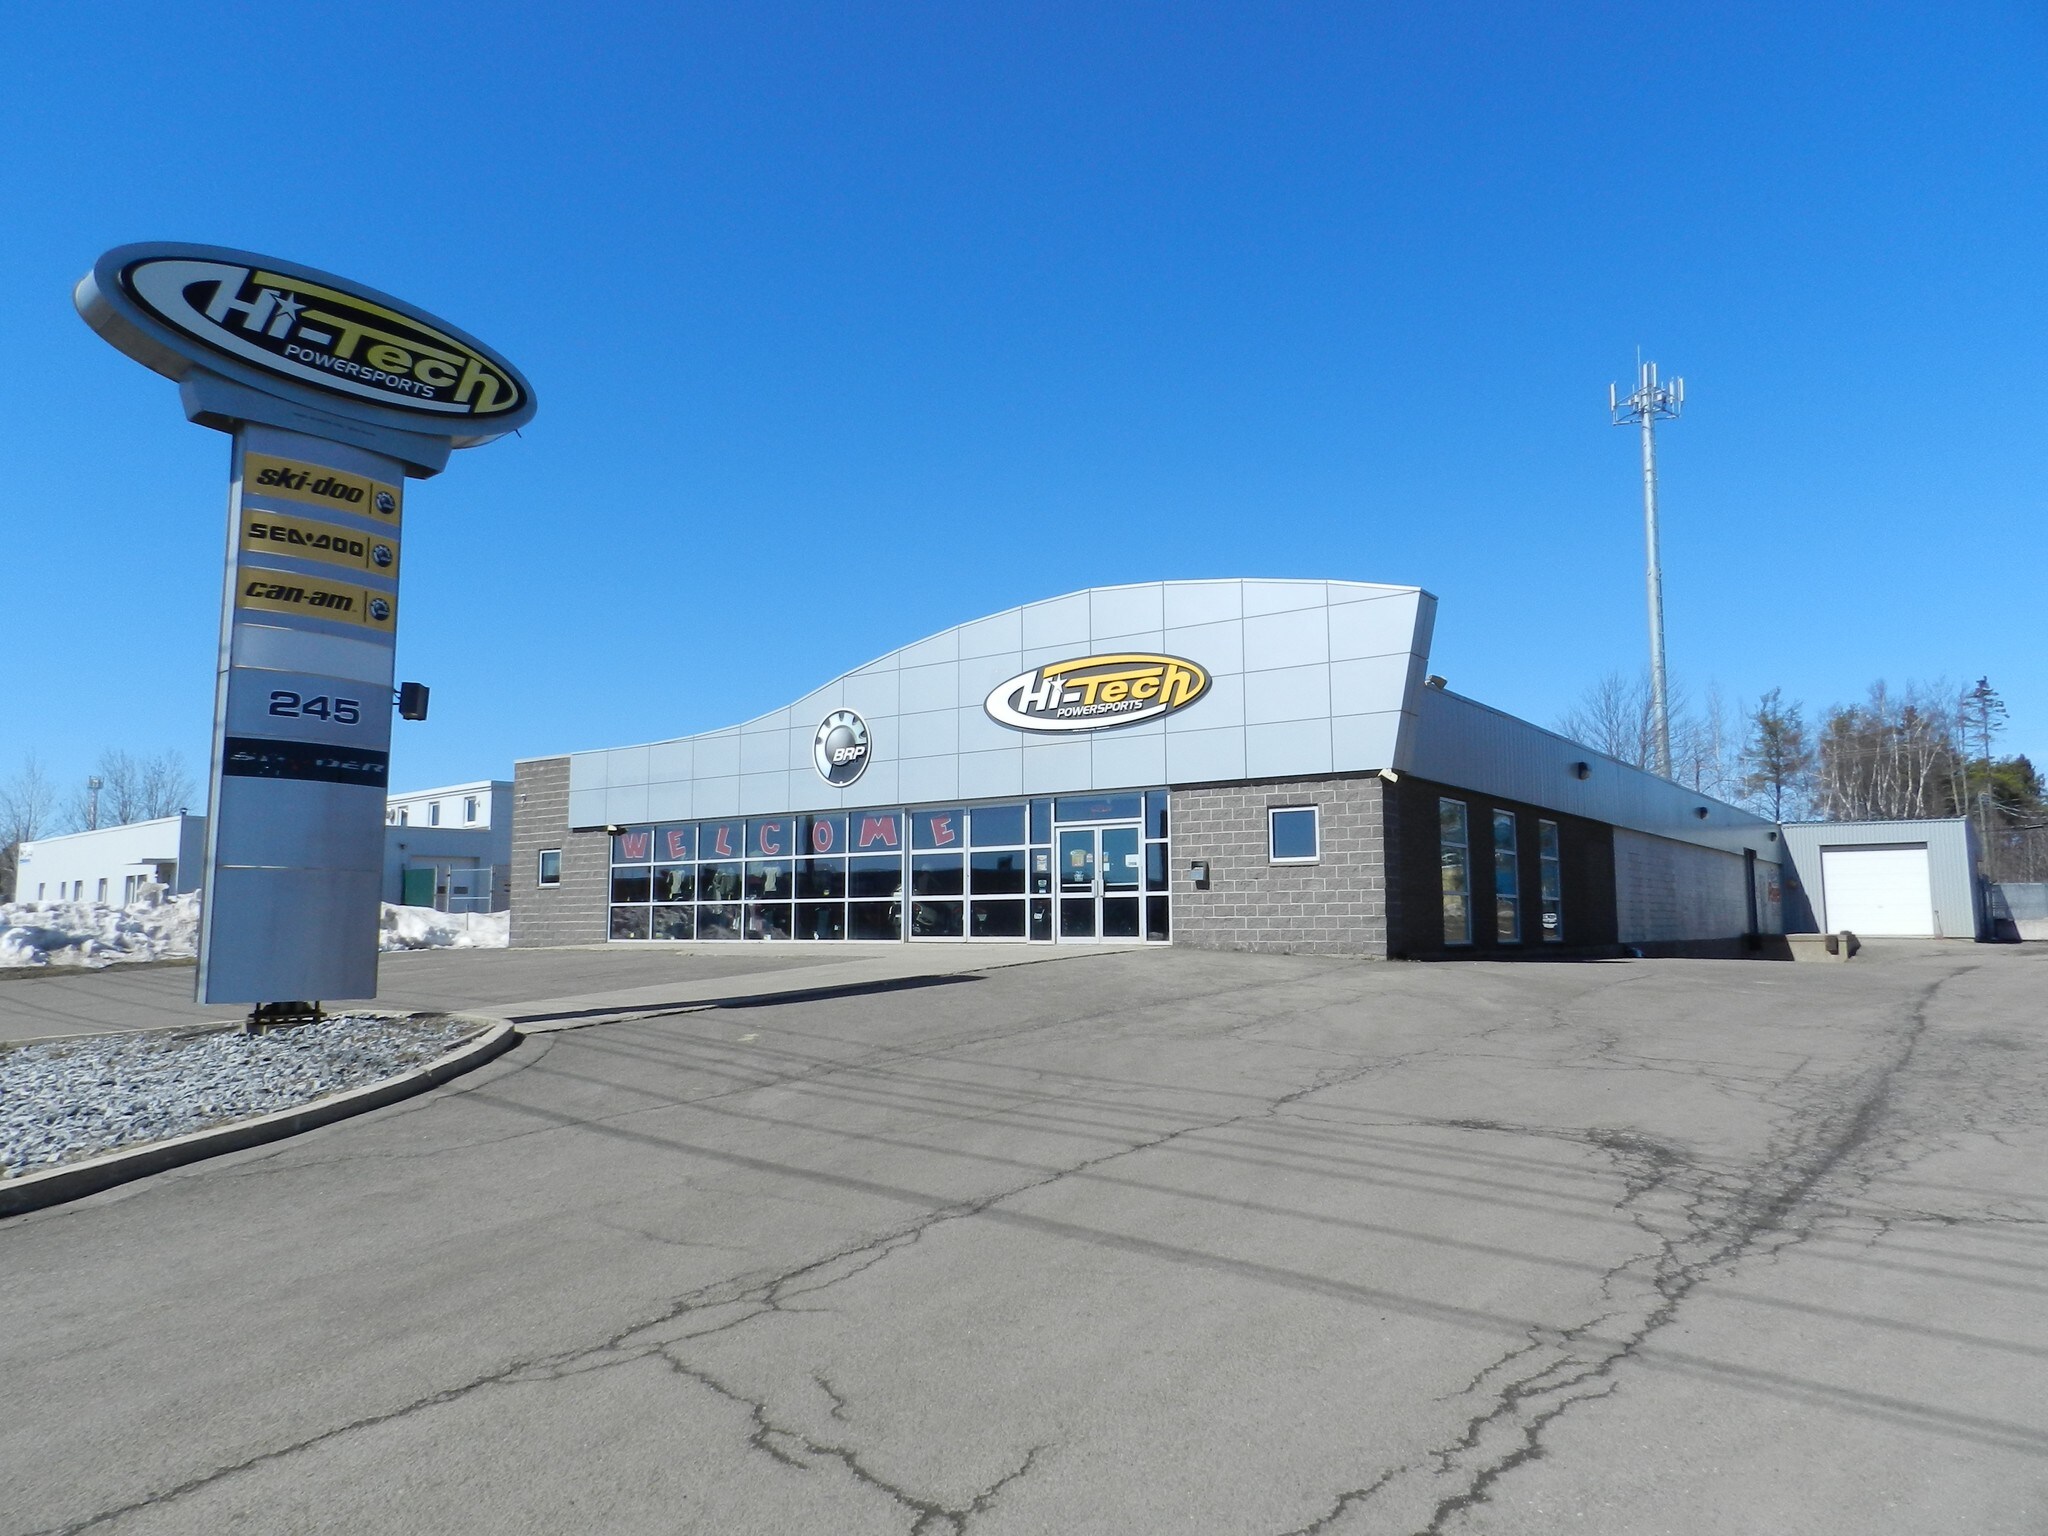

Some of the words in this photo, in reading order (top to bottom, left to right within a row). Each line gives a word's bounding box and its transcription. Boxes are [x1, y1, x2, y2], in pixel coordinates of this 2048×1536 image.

[199, 262, 512, 414] Hi-Tech
[284, 343, 436, 399] POWERSPORTS
[256, 467, 365, 504] ski-doo
[245, 581, 354, 612] can-am
[1014, 660, 1200, 714] Hi-Tech
[268, 689, 361, 726] 245
[1057, 699, 1144, 719] POWERSPORTS
[832, 746, 866, 762] BRP
[621, 813, 956, 860] WELCOME
